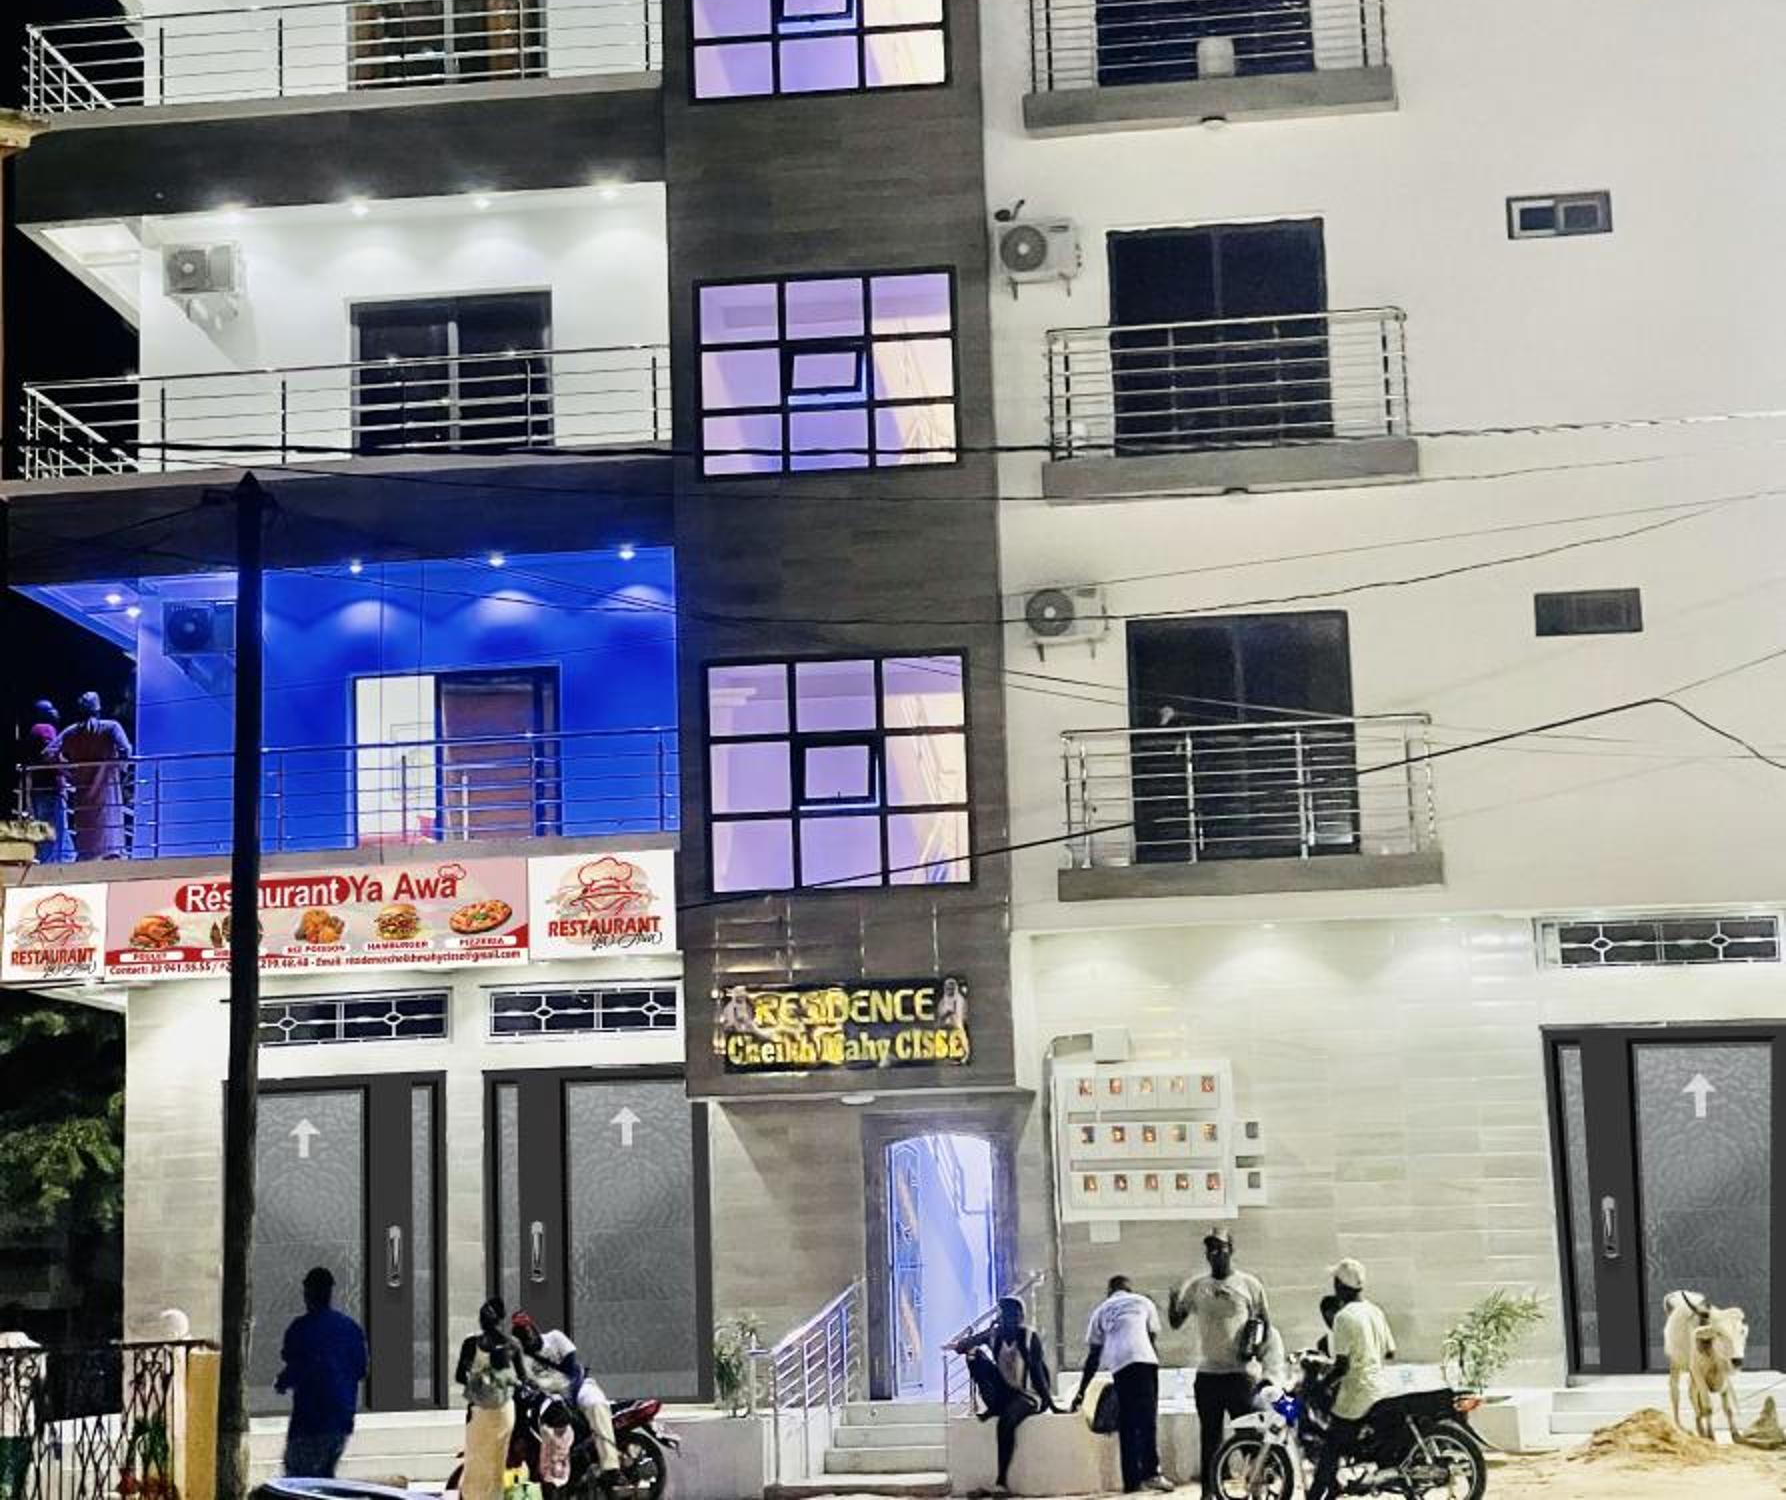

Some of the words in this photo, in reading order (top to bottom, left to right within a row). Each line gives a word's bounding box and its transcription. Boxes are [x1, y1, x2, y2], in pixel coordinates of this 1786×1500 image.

[186, 879, 340, 912] Résurant
[349, 875, 383, 903] Ya
[393, 871, 459, 901] Awa
[548, 916, 661, 937] RESTAURANT
[11, 947, 97, 966] RESTAURANT
[367, 941, 429, 951] HAMBURGER
[753, 987, 936, 1026] RESIDENCE
[727, 1033, 816, 1066] Cheikh
[818, 1030, 890, 1068] Mahy
[895, 1028, 965, 1061] CISSE
